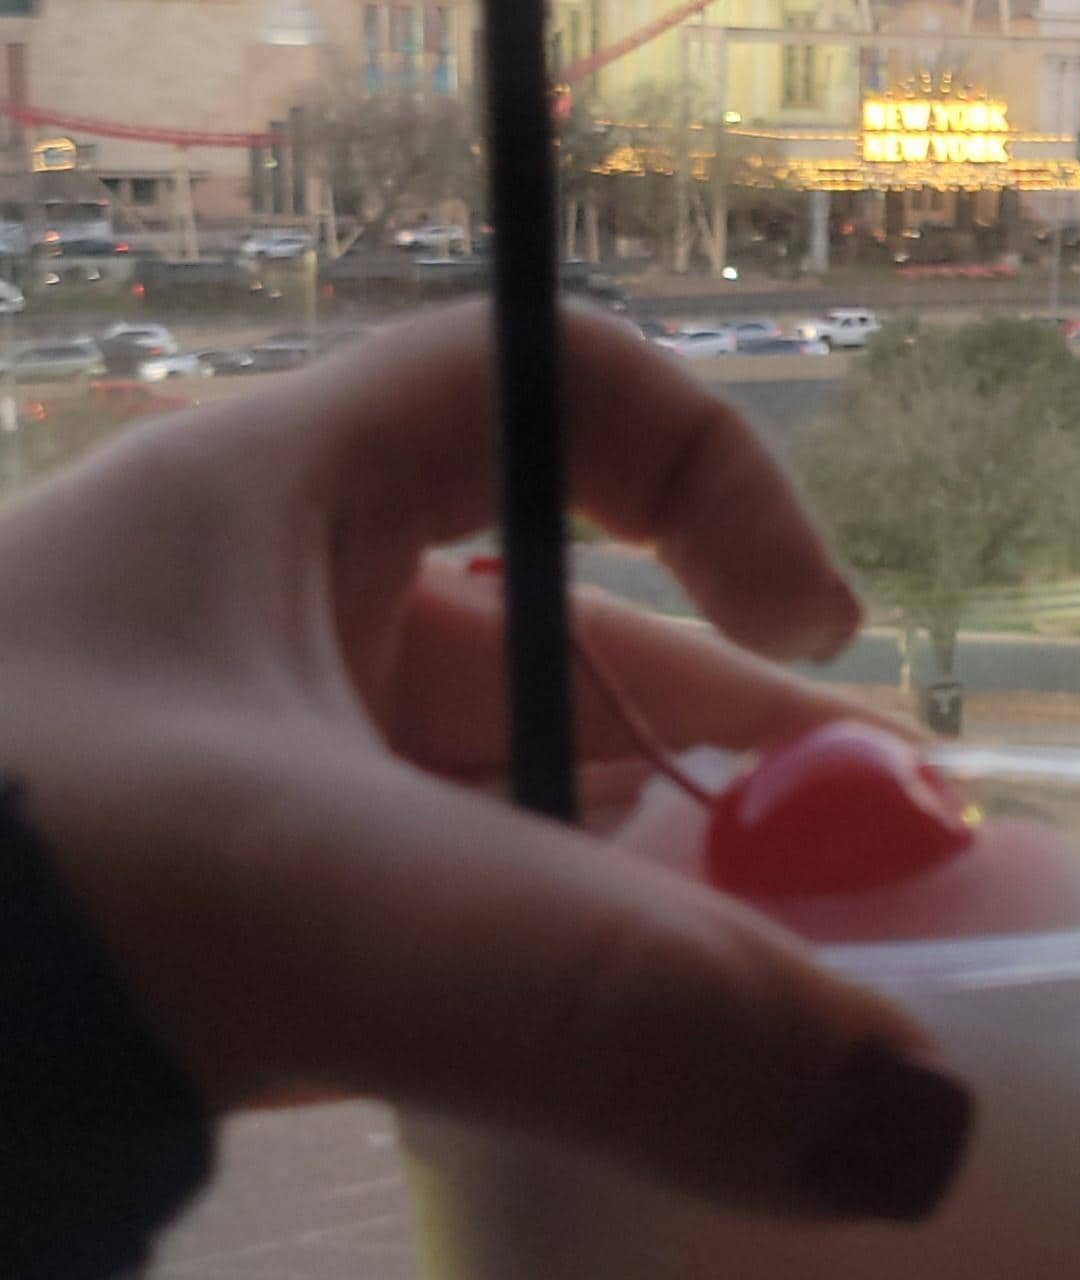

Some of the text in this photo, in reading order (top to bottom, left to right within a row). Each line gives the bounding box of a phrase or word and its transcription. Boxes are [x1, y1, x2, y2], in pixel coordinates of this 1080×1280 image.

[863, 99, 1009, 132] NEW YORK
[863, 132, 1009, 163] NEW YORK
